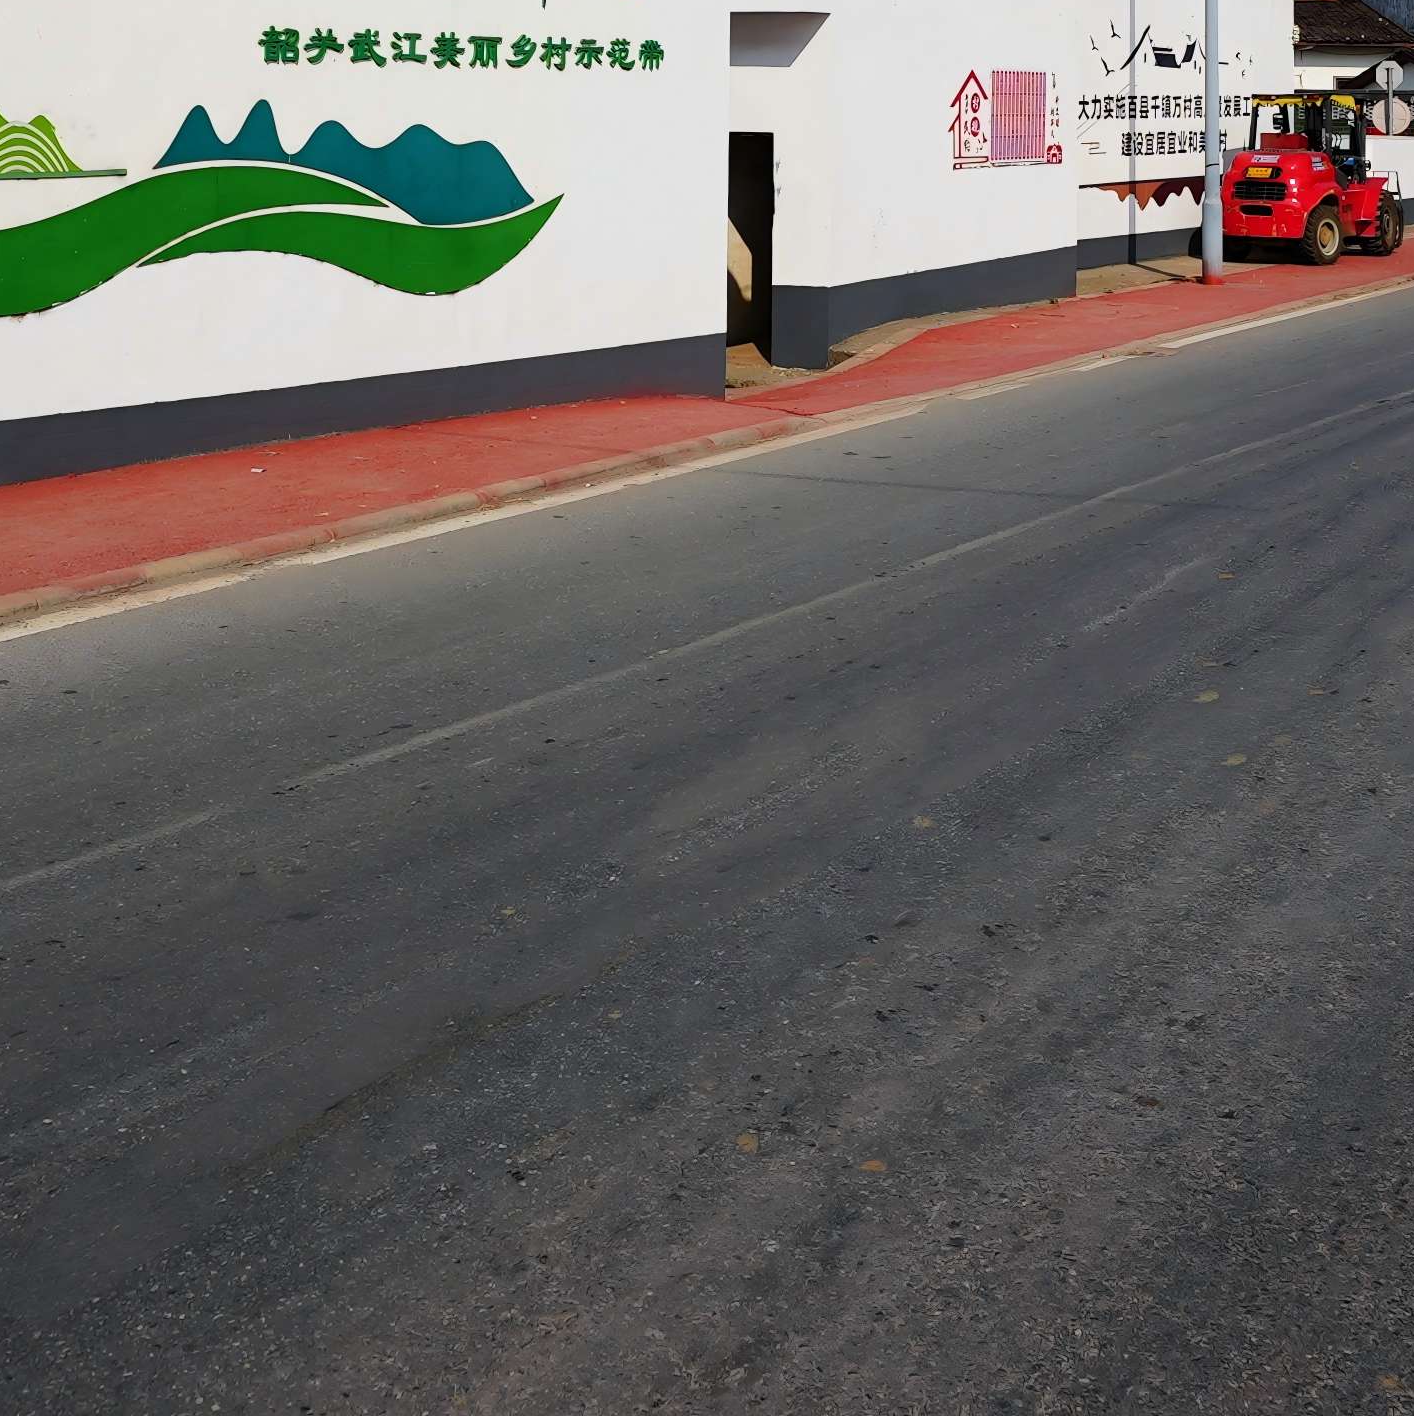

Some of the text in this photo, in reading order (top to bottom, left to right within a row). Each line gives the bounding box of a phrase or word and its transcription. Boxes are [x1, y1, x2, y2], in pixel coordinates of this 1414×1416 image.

[258, 26, 664, 72] 韶关武江美丽乡村示范带
[1078, 94, 1259, 120] 大力实施百县千镇万村高发展工
[1121, 129, 1228, 156] 建设宜居宜业和美村
